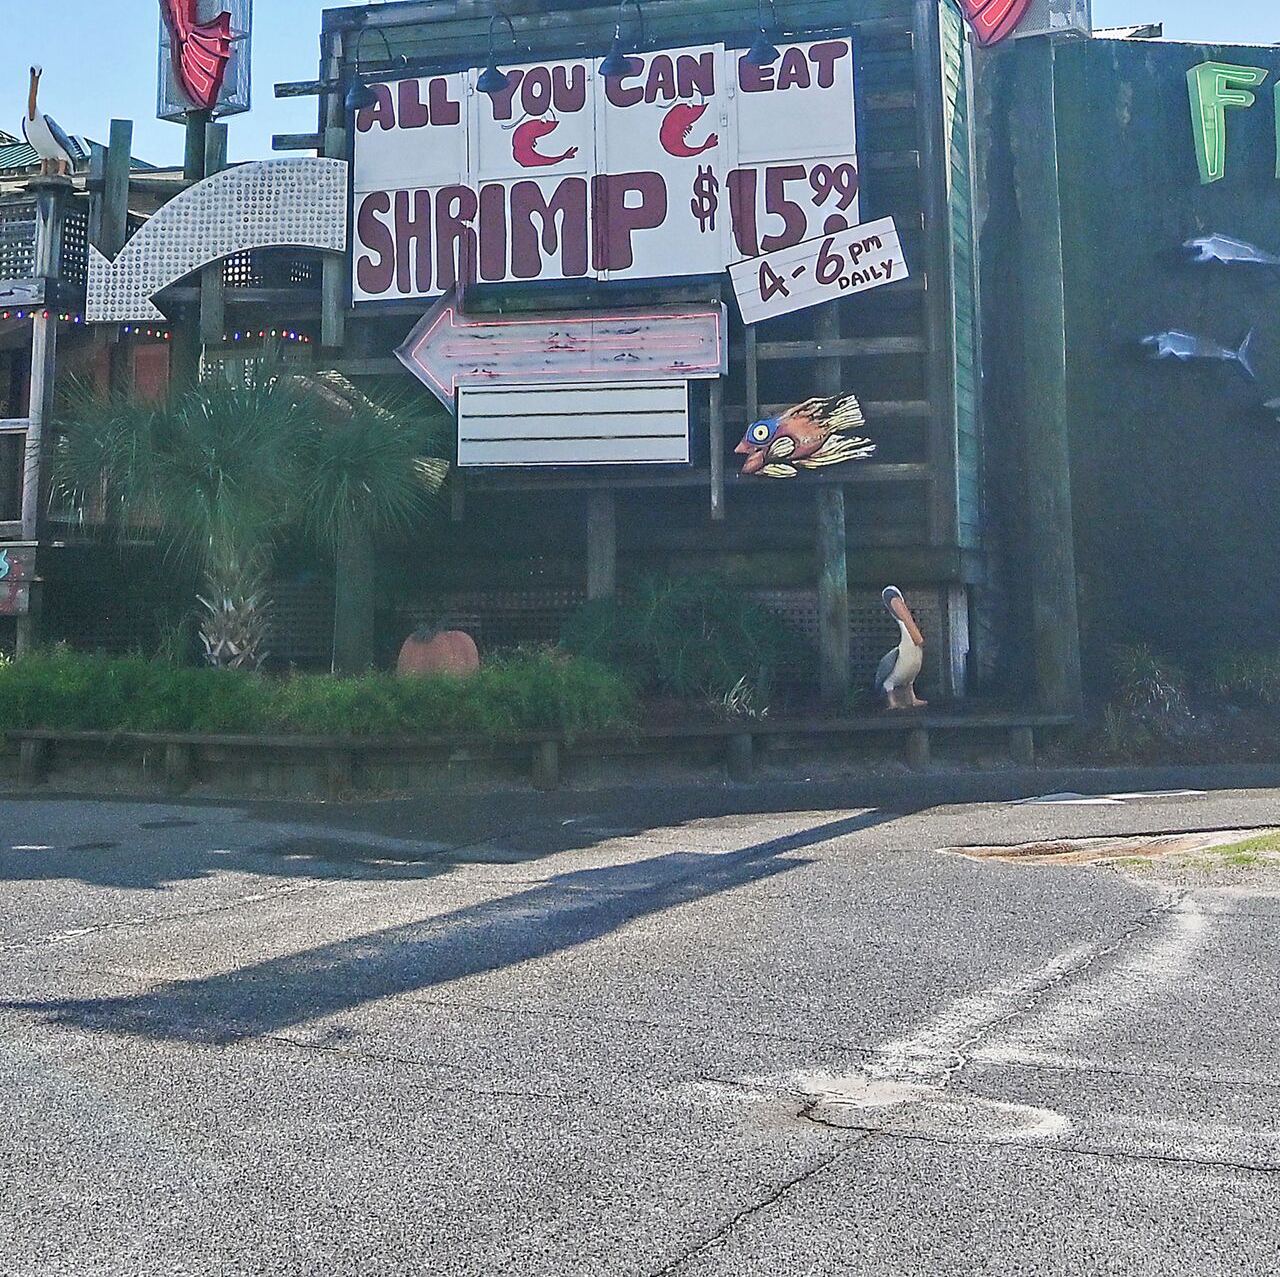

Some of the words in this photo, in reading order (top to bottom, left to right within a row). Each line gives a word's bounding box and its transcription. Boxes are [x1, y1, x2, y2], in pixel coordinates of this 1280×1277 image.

[357, 77, 461, 132] ALL
[480, 63, 586, 121] YOU
[603, 51, 716, 108] CAN
[738, 41, 849, 93] EAT
[356, 170, 668, 295] SHRIMP
[837, 258, 894, 291] DAILY
